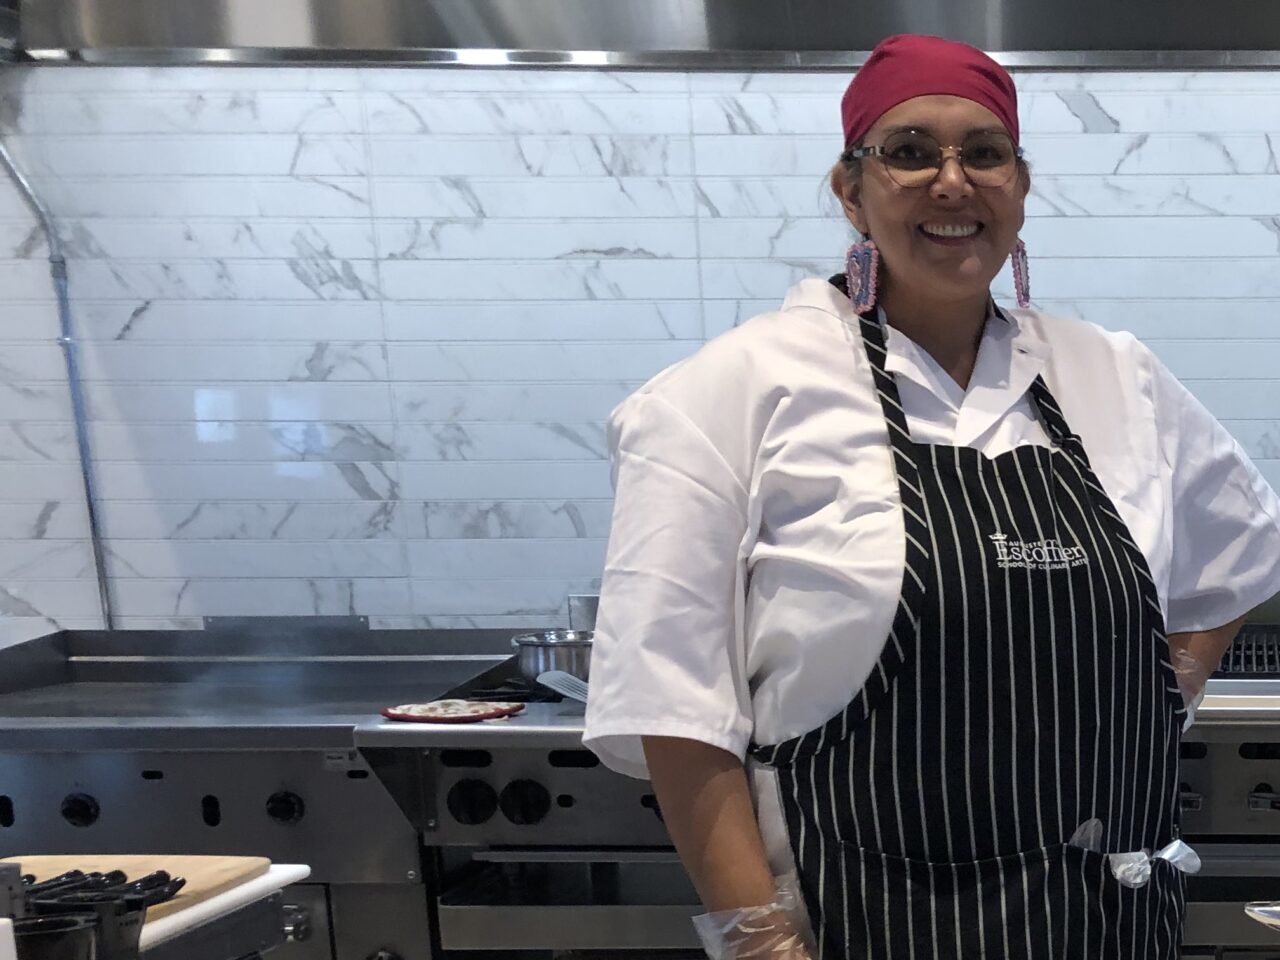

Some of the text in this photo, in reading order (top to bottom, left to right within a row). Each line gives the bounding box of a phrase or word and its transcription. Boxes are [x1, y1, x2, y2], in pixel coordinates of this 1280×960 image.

[992, 539, 1086, 562] Escoffier
[997, 561, 1027, 569] SCHOOL
[1028, 562, 1037, 570] OF
